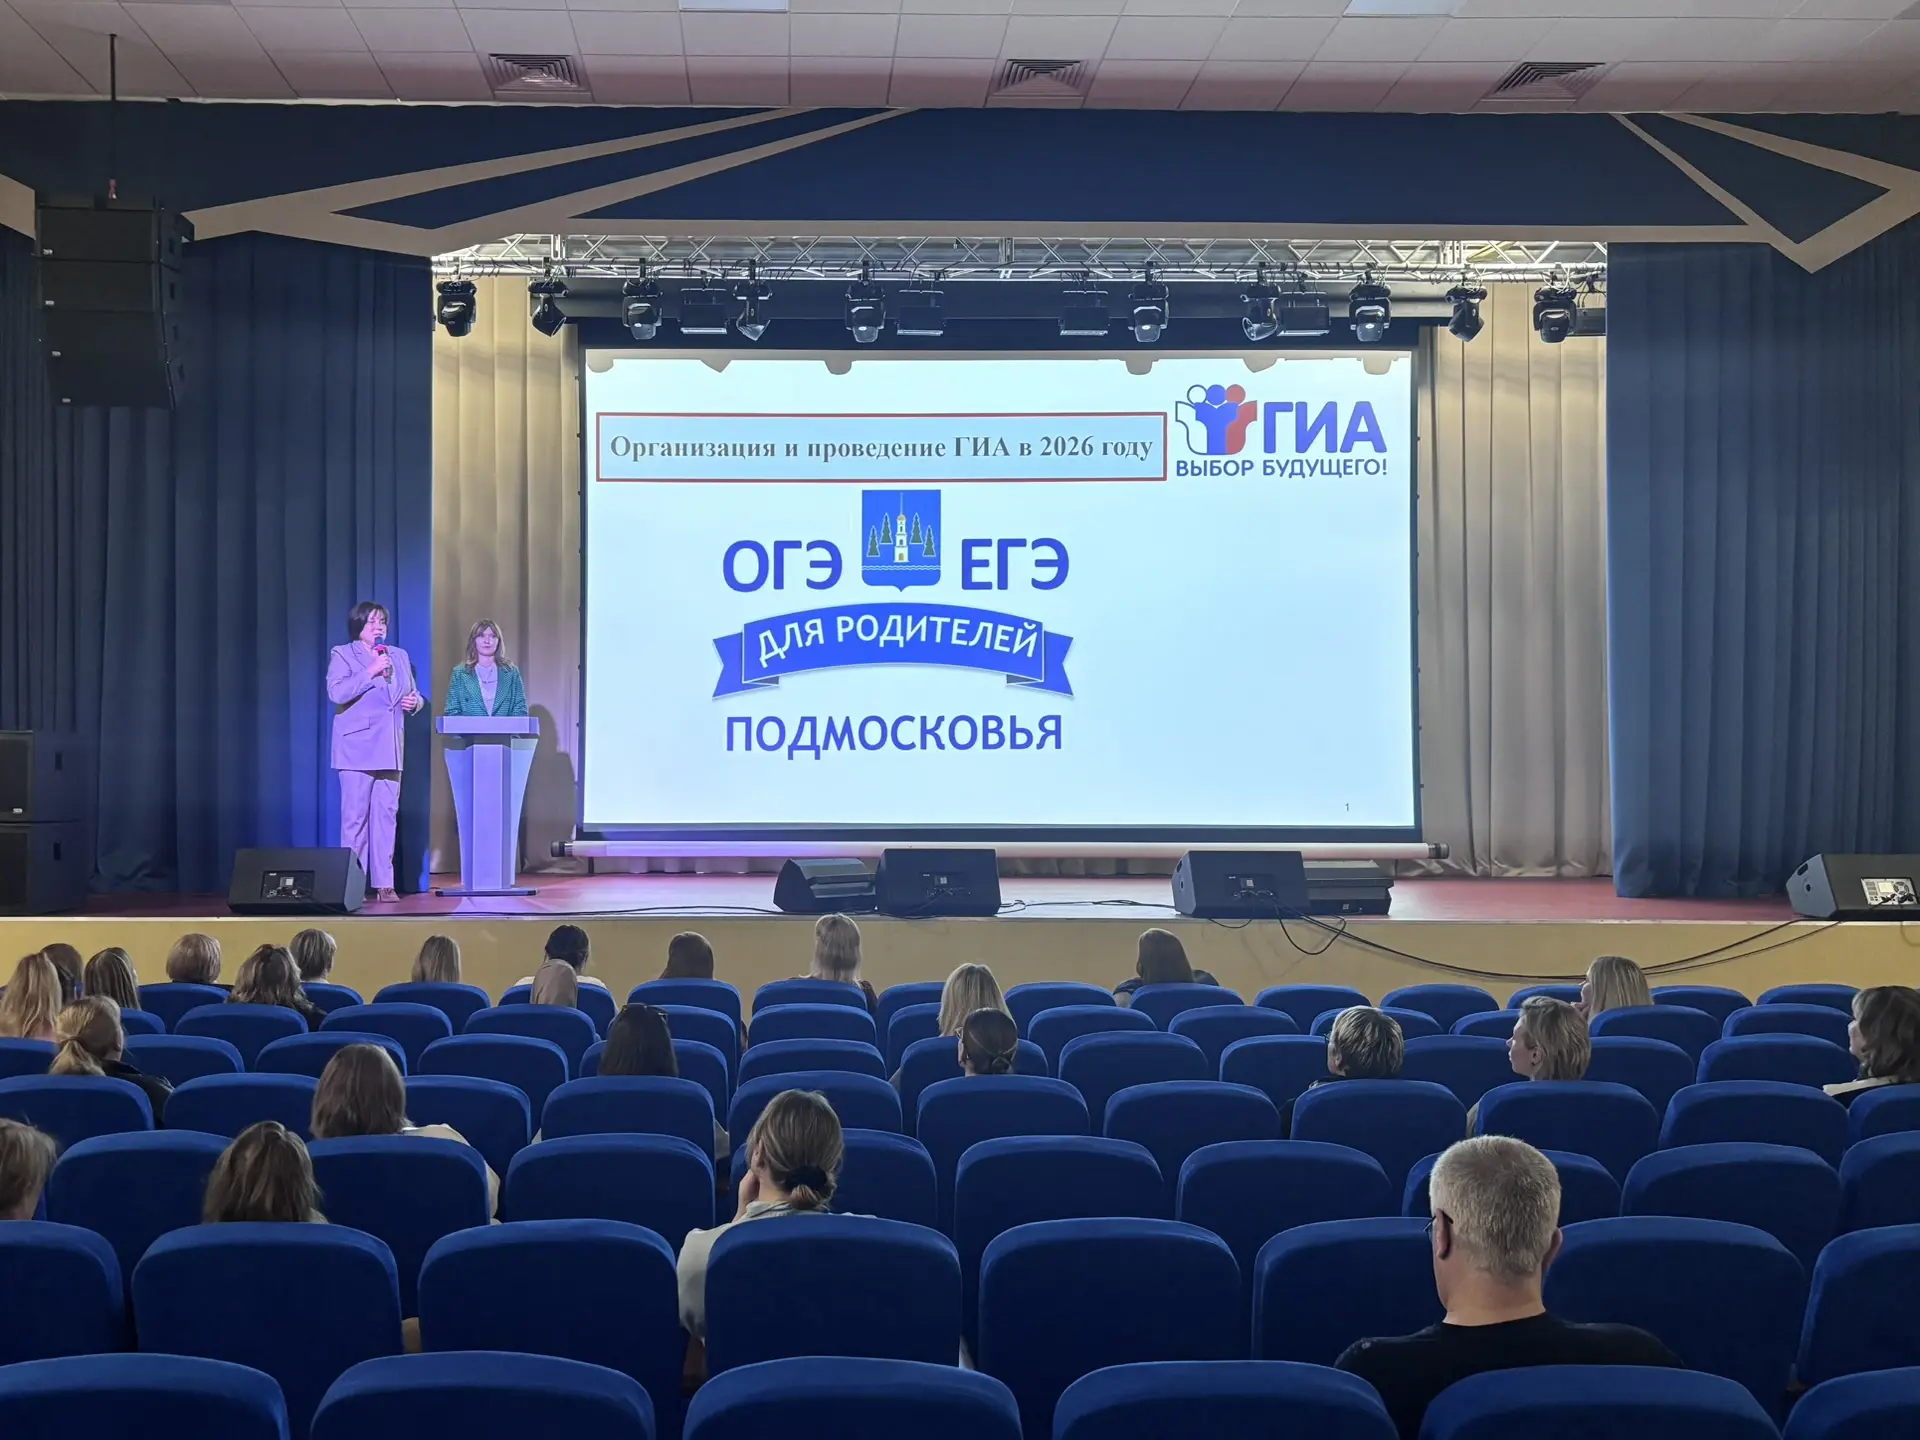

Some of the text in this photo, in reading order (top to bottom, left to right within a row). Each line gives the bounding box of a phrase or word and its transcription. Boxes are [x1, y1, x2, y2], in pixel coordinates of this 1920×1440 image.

[610, 435, 1154, 463] Организация и проведение ГИА в 2026 году
[1263, 400, 1388, 454] ГИА
[1176, 458, 1388, 479] ВЫБОР БУДУЩЕГО!
[722, 539, 843, 593] ОГЭ
[961, 537, 1070, 591] ЕГЭ
[758, 613, 1039, 668] ДЛЯ РОДИТЕЛЕЙ
[726, 714, 1063, 761] ПОДМОСКОВЬЯ
